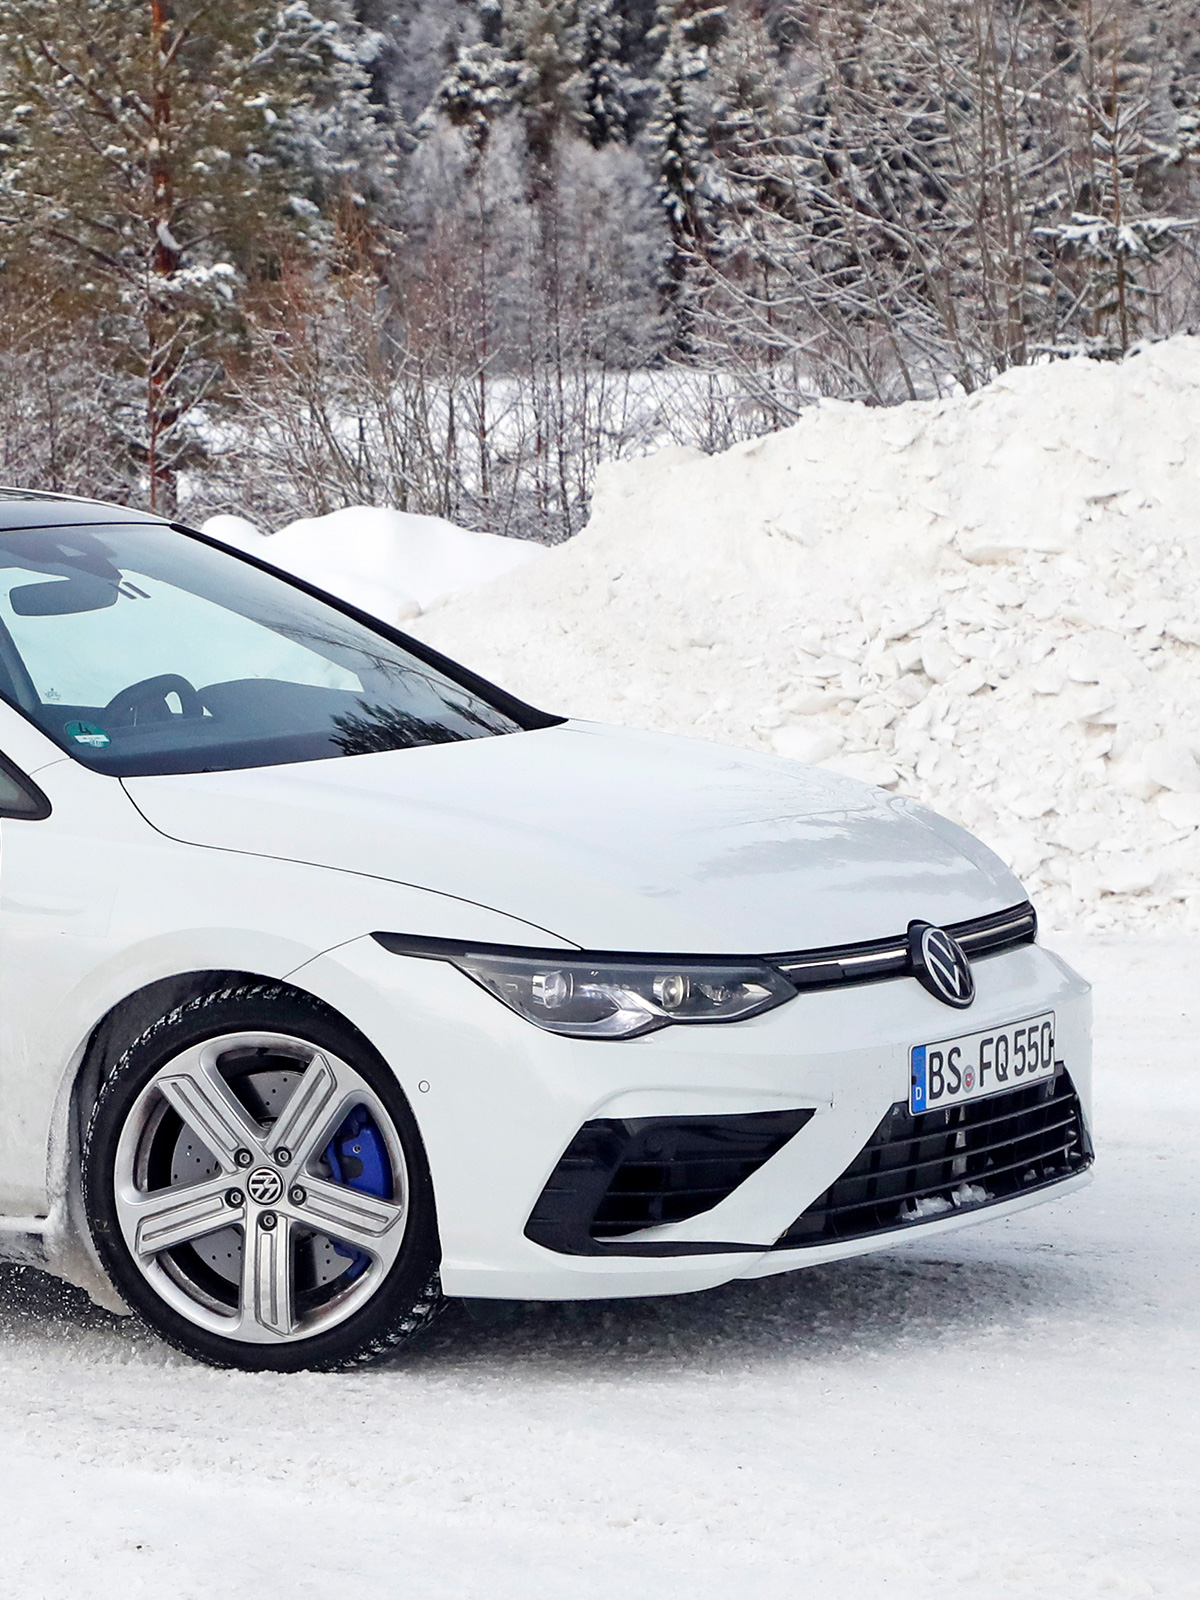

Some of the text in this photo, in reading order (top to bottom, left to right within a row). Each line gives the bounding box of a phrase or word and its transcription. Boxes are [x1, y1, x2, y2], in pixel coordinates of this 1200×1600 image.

[929, 1047, 961, 1100] BS
[979, 1035, 1008, 1087] FQ
[1014, 1022, 1052, 1076] 550
